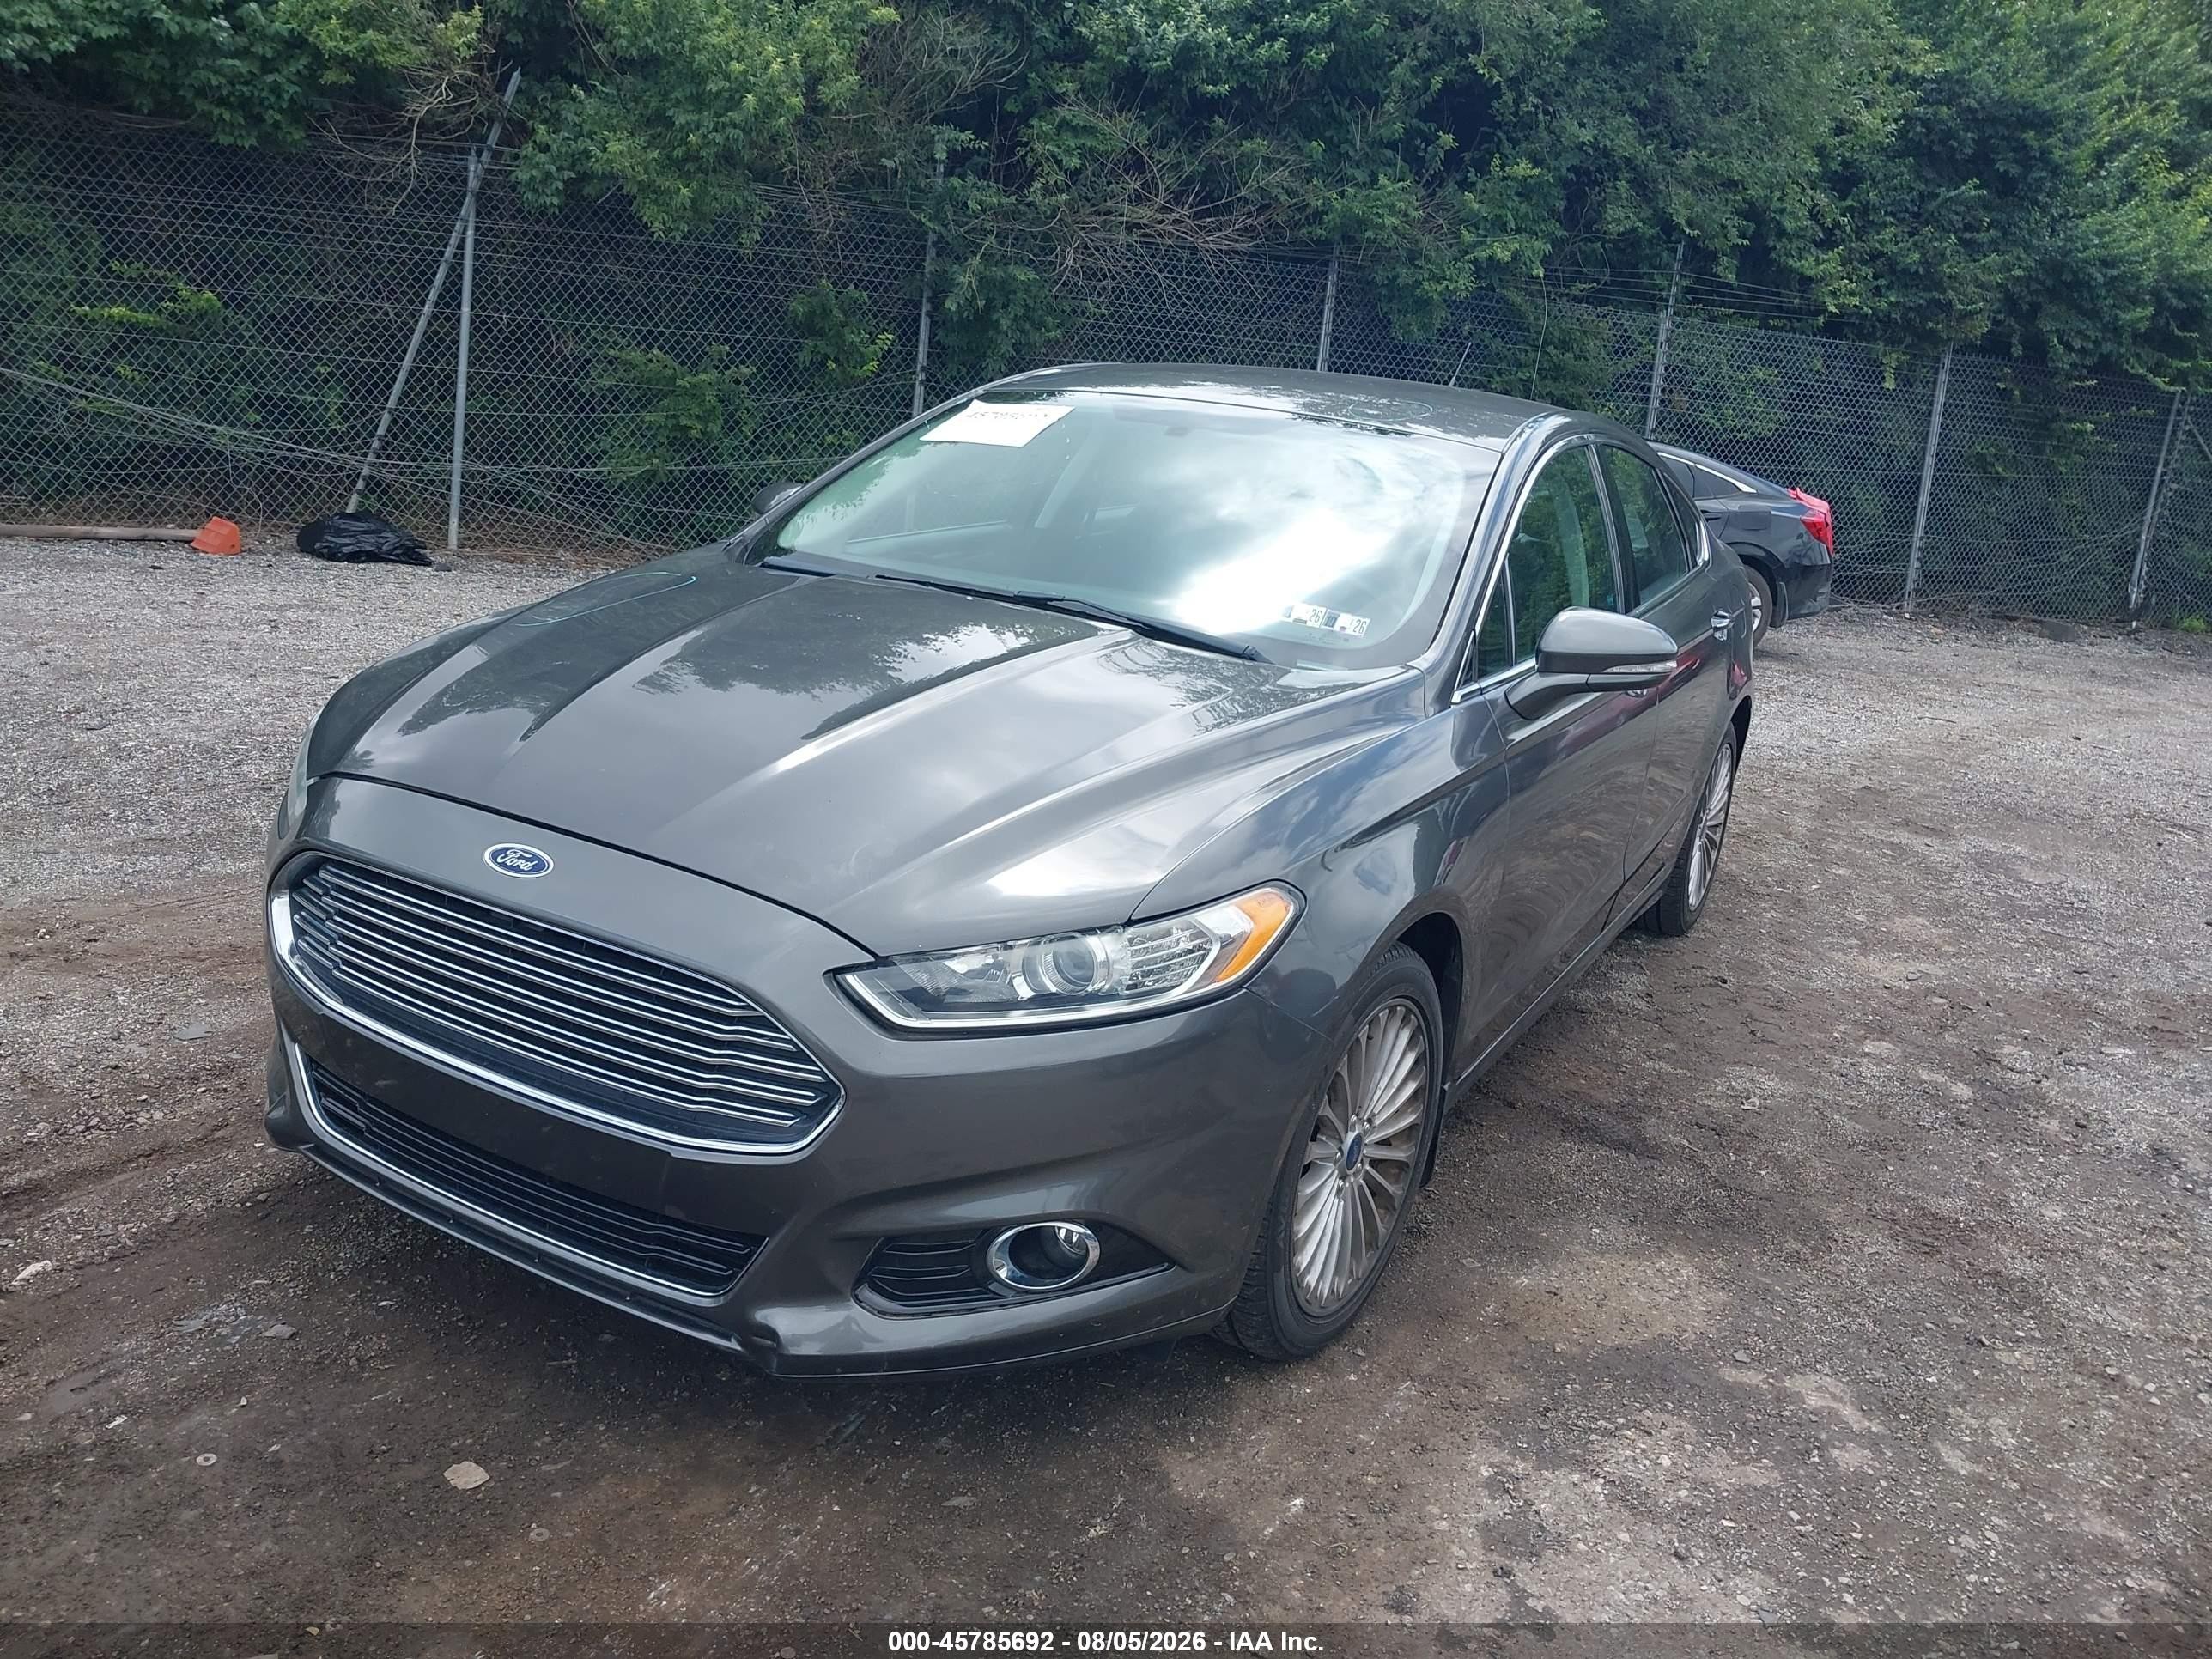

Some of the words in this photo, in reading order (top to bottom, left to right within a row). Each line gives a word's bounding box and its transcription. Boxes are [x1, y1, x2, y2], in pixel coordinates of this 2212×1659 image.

[1309, 607, 1322, 623] 26
[1352, 618, 1367, 634] 26
[496, 848, 538, 871] Ford
